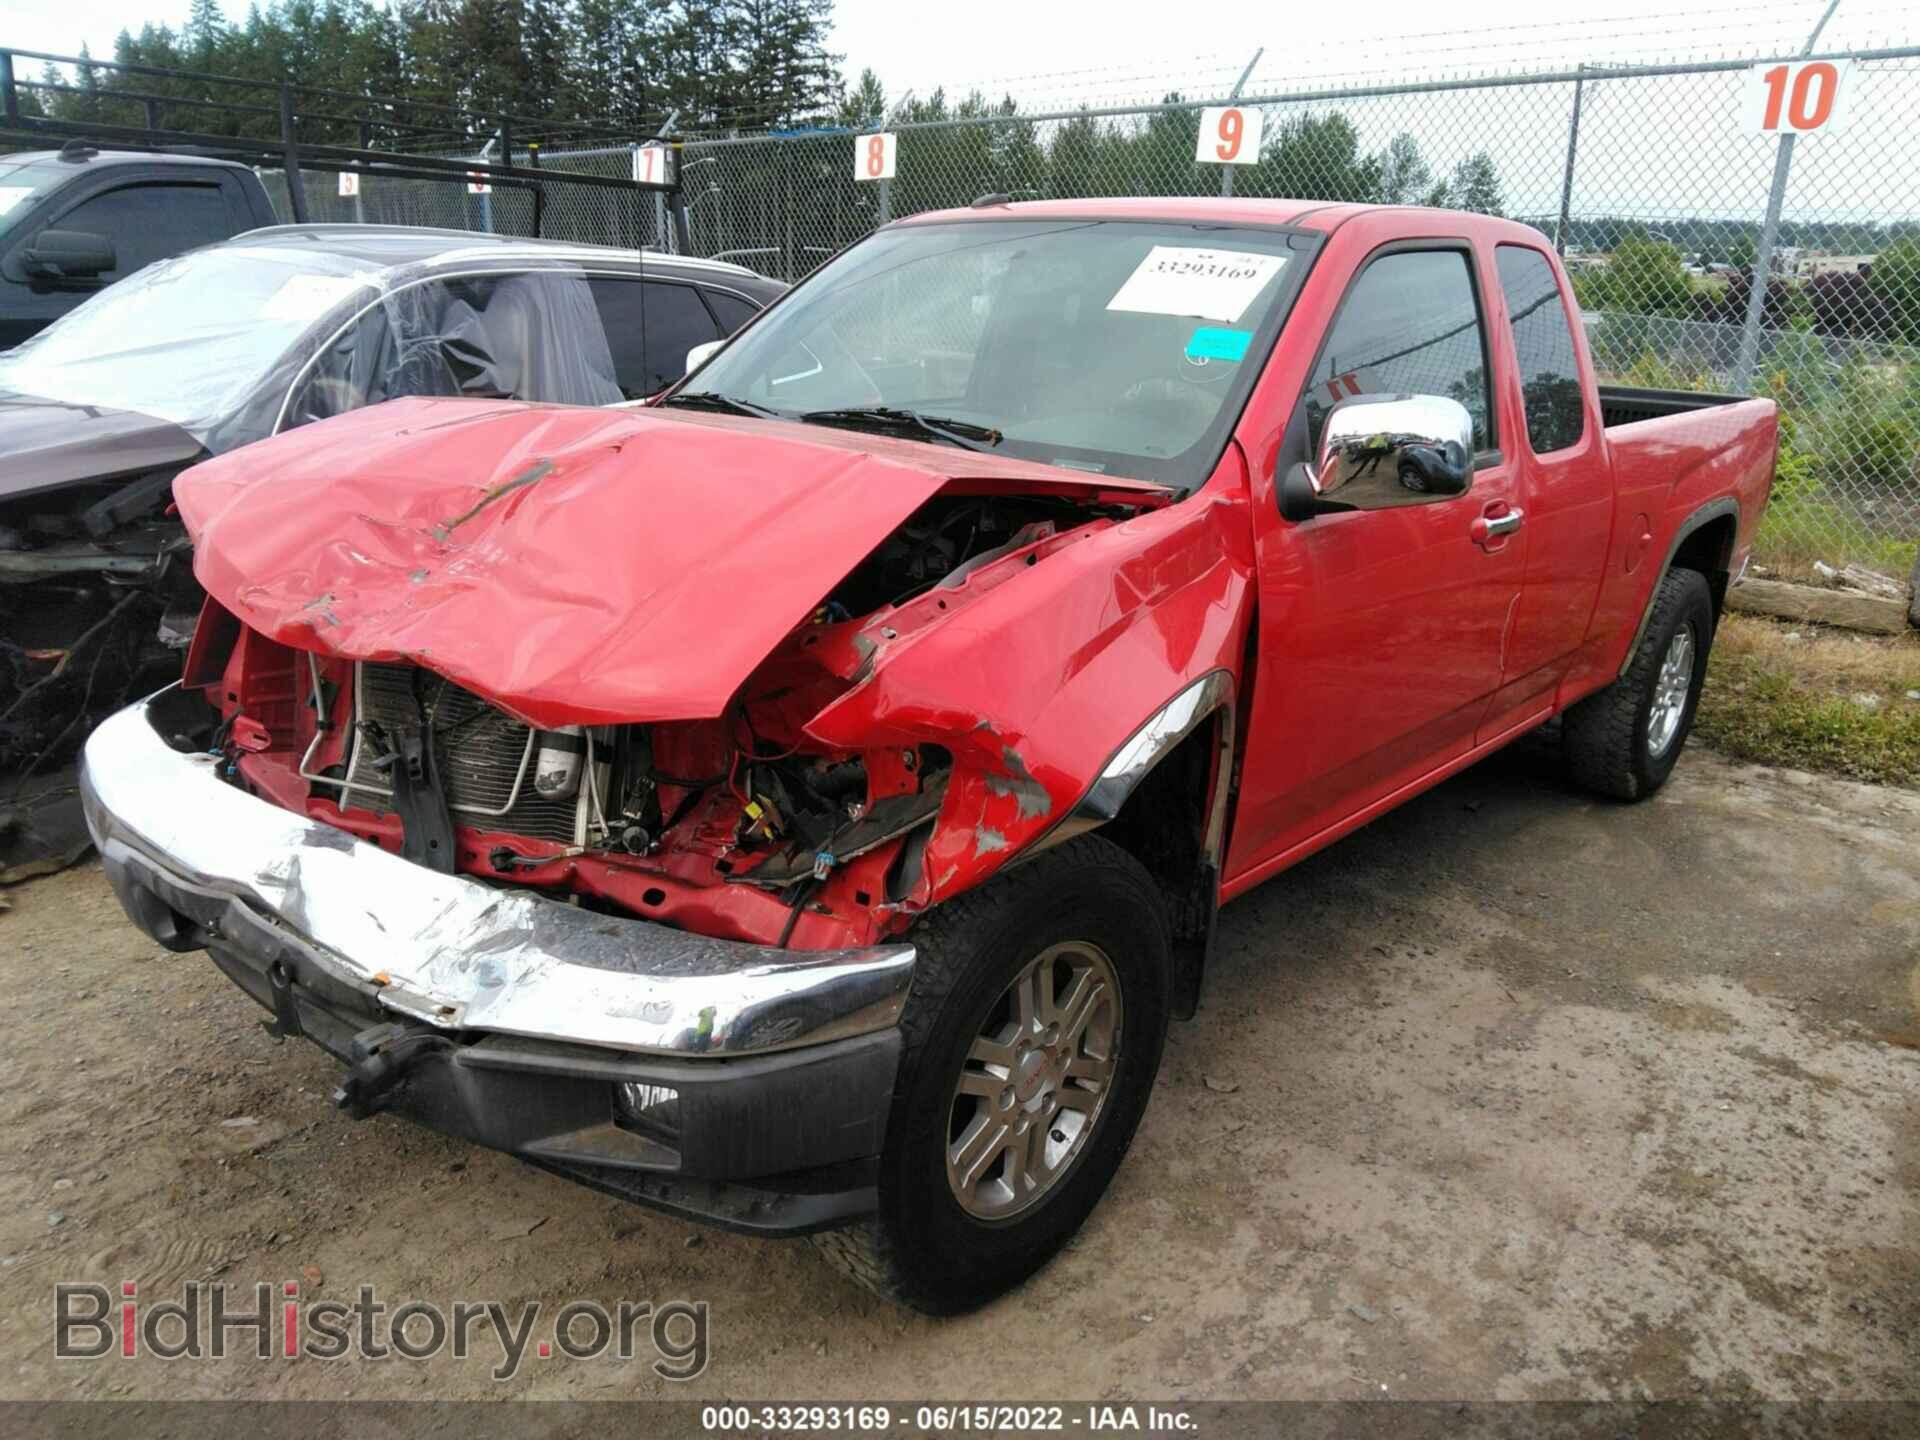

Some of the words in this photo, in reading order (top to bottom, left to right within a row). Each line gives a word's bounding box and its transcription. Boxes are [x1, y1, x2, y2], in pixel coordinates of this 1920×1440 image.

[1762, 61, 1838, 130] 10
[1215, 109, 1244, 160] 9
[643, 149, 654, 183] 7
[866, 135, 884, 177] 8
[1150, 260, 1257, 279] 33293169
